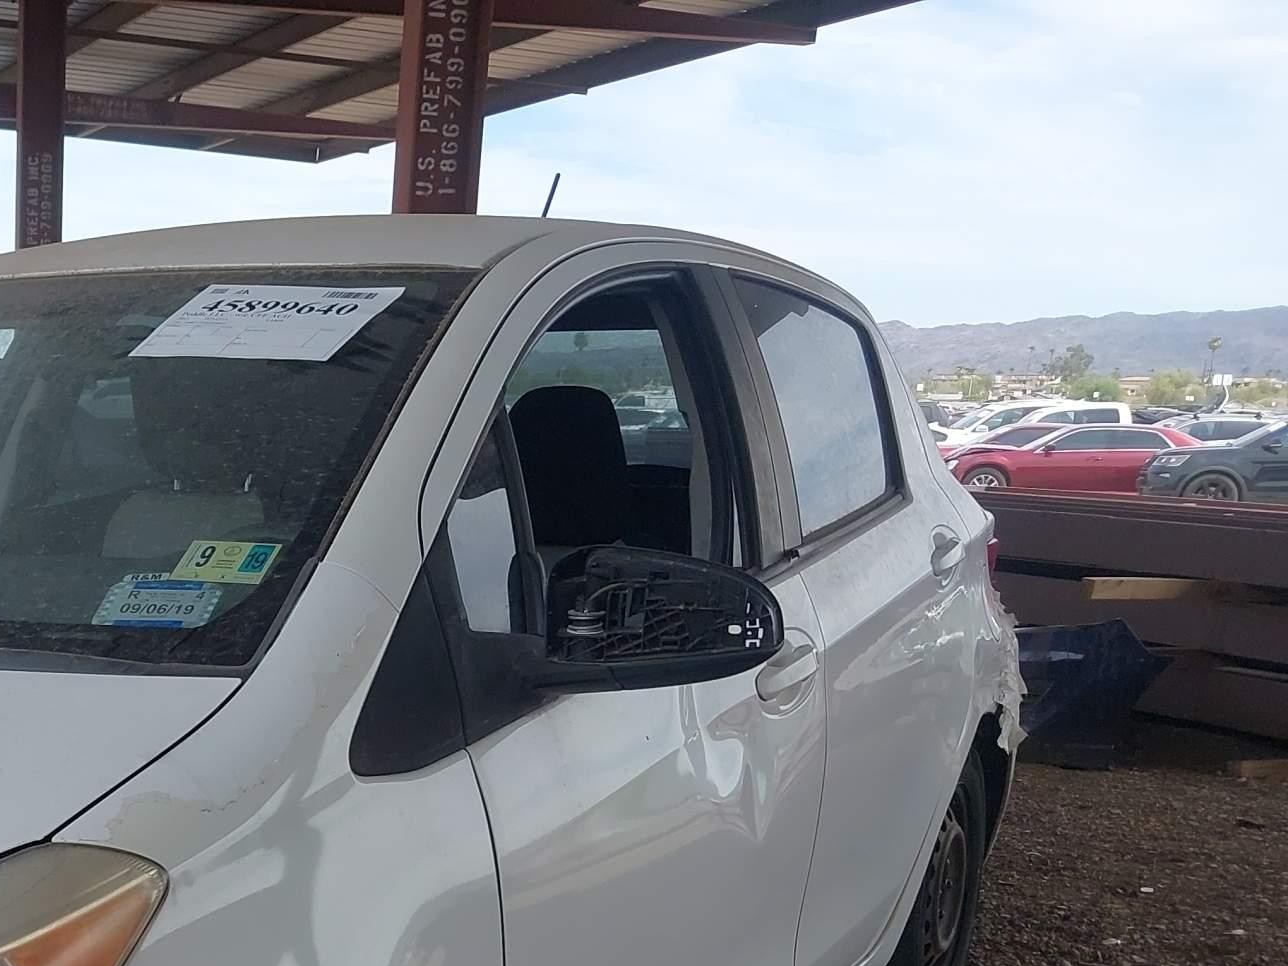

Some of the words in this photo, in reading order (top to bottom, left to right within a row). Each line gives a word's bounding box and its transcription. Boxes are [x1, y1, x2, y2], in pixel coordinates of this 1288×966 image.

[419, 33, 444, 133] PREFAB
[415, 149, 437, 196] U.S.
[26, 187, 39, 246] PREFAB
[201, 298, 360, 316] 45899640
[194, 545, 216, 568] 9
[244, 551, 269, 571] 19
[127, 590, 140, 599] R
[119, 603, 195, 615] 09/06/19
